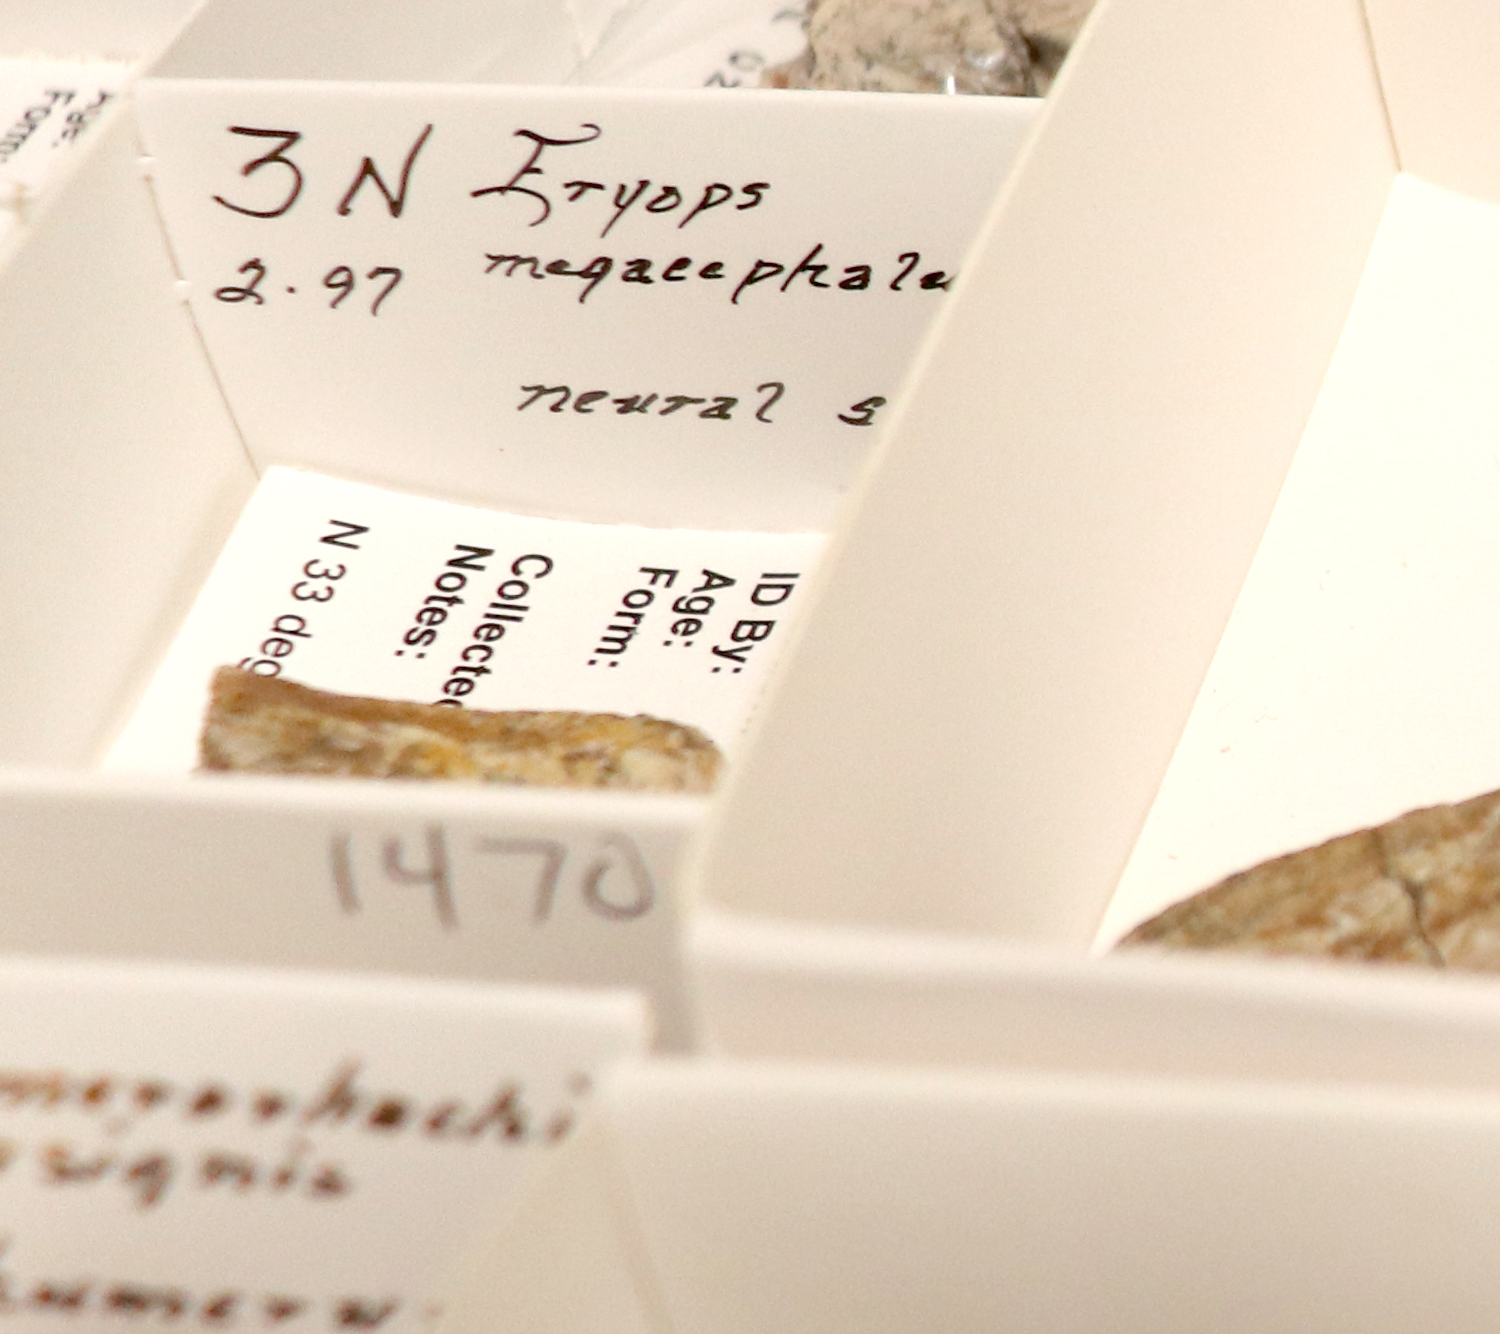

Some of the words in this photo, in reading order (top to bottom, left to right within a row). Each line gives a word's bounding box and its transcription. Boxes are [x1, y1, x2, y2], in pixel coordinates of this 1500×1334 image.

[211, 125, 305, 219] 3
[335, 122, 434, 220] N
[470, 122, 772, 239] Eryops
[212, 258, 403, 318] 2.97
[515, 380, 787, 425] neural
[318, 517, 371, 551] N
[290, 557, 349, 606] 33
[393, 542, 496, 661] Notes:
[661, 567, 739, 651] Age:
[750, 569, 801, 608] ID
[587, 565, 681, 670] Form:
[709, 618, 777, 676] By:
[327, 822, 657, 931] 1470
